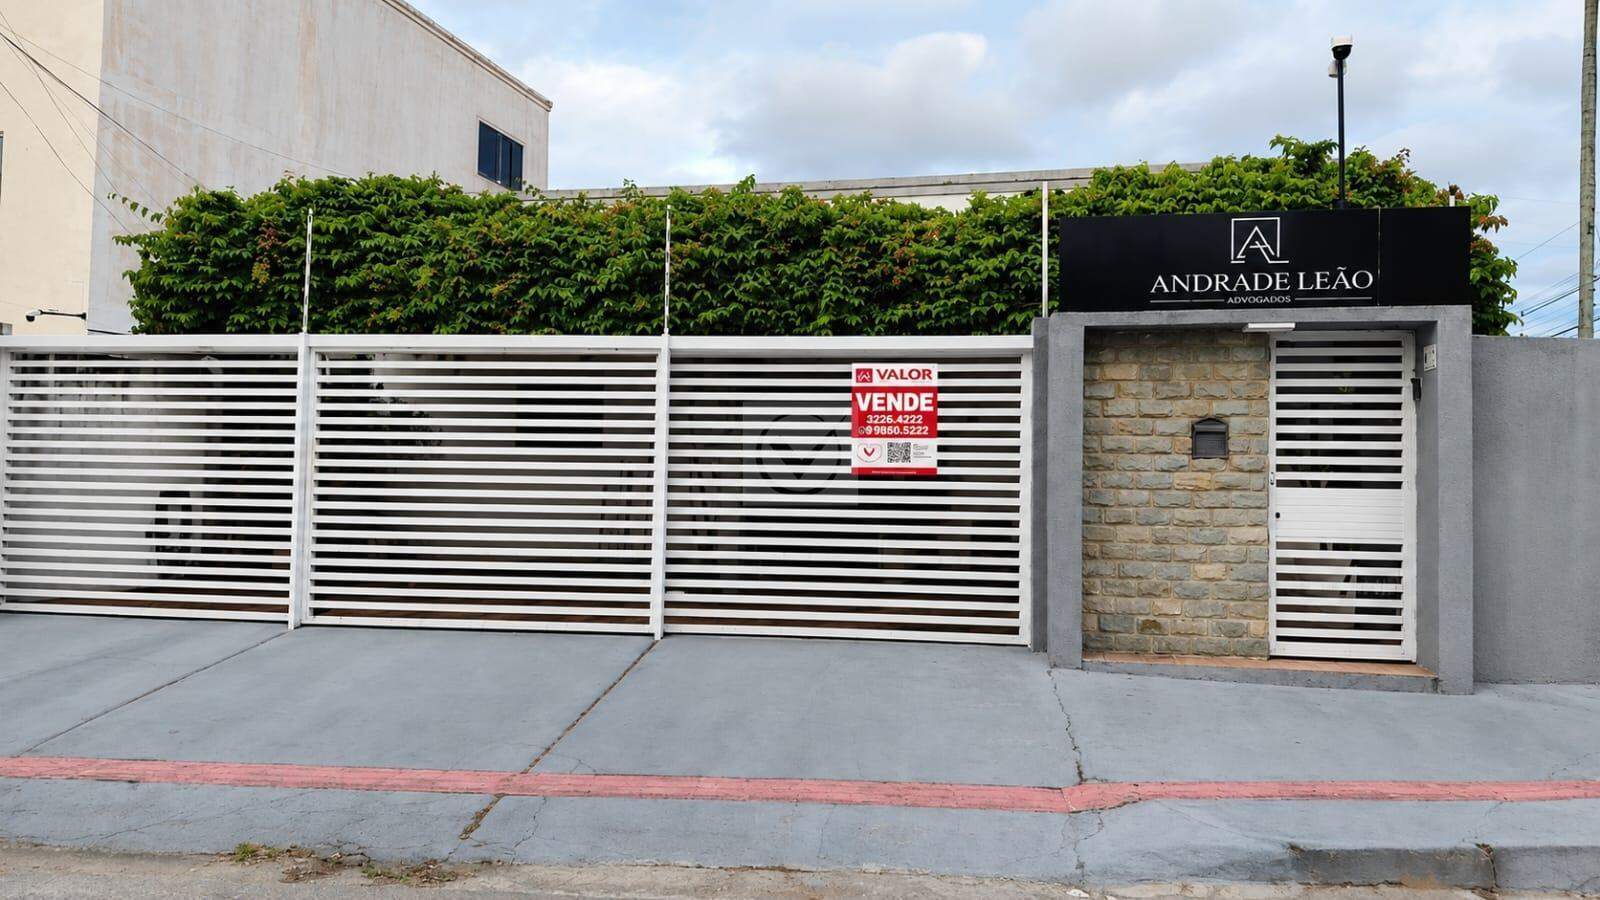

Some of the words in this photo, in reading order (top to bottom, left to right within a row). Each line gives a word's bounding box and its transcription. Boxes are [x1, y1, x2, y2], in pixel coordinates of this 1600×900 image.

[1150, 272, 1291, 293] ANDRADE
[1297, 266, 1374, 290] LEÃO
[1226, 295, 1292, 304] ADVOGADOS
[876, 368, 933, 380] VALOR
[855, 392, 934, 412] VENDE
[866, 414, 923, 424] 3226.4222
